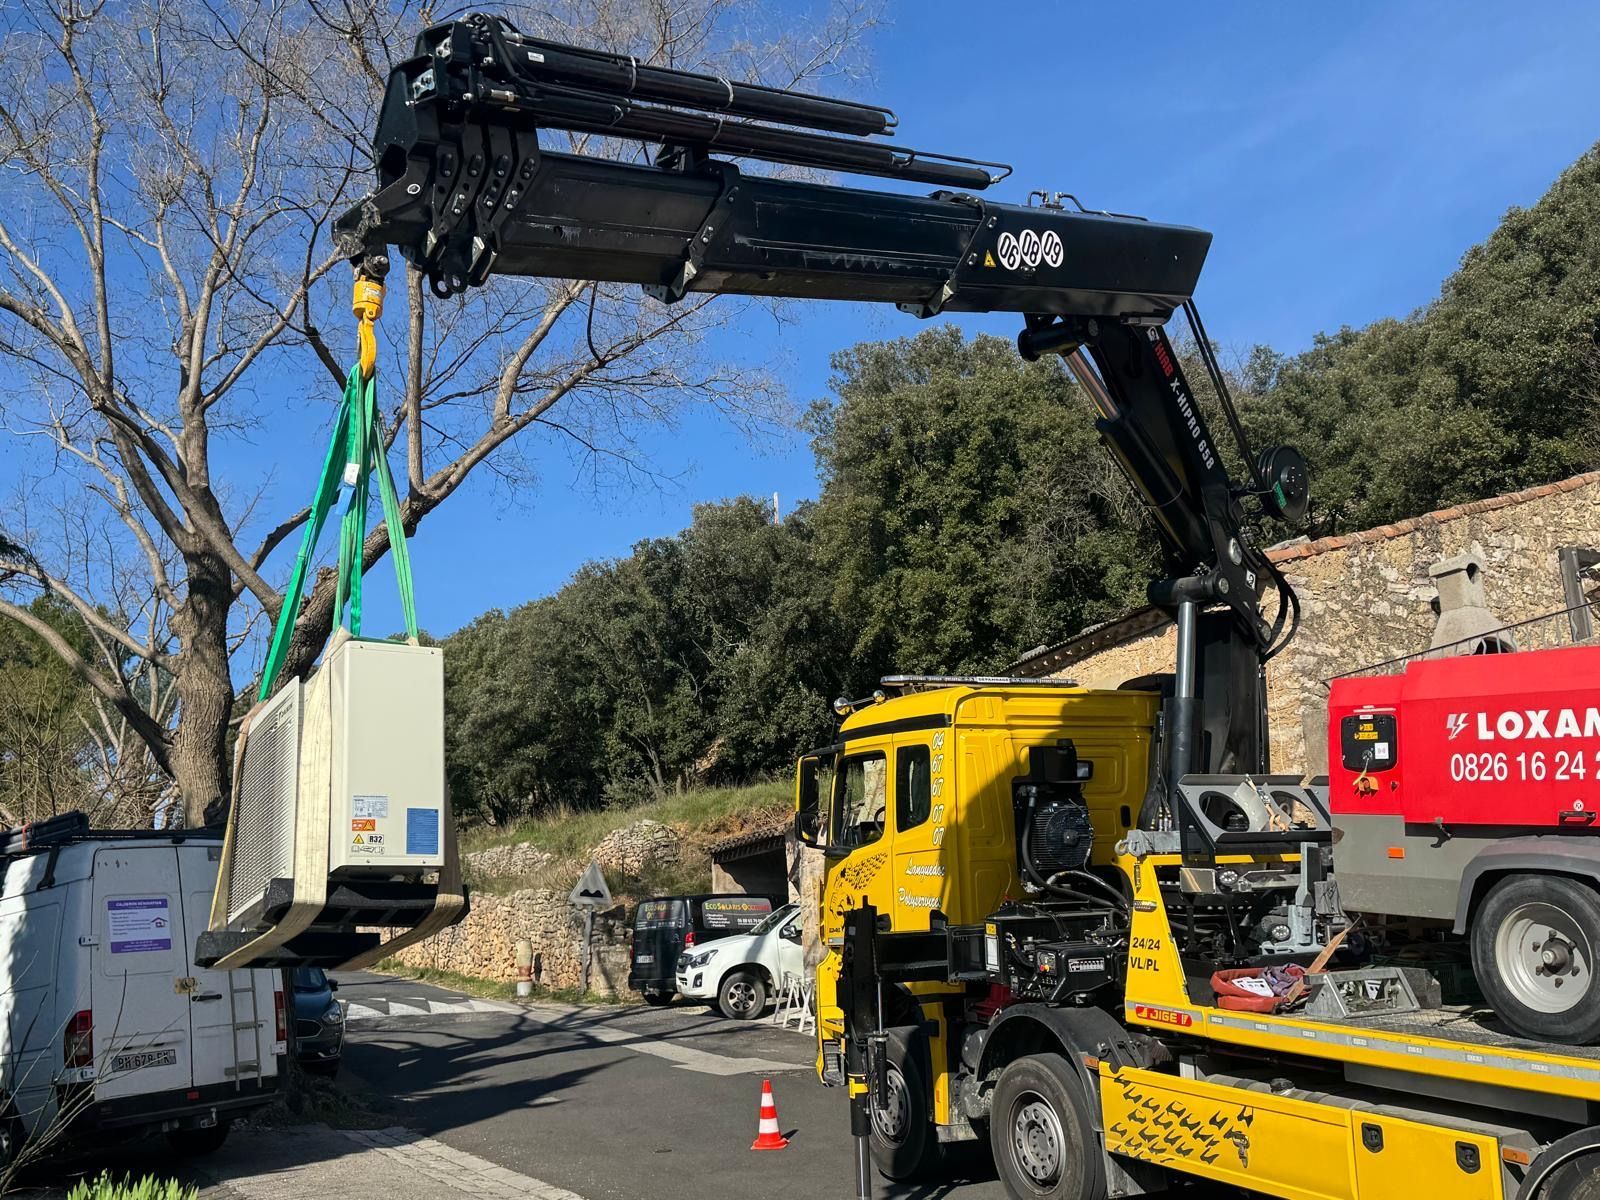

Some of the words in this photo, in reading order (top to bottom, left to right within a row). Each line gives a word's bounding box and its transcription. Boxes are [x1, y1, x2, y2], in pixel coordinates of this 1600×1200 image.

[1154, 342, 1174, 377] HIAB
[1170, 377, 1201, 439] X-HIPRO
[1198, 439, 1215, 470] 658
[932, 732, 945, 751] 04
[932, 754, 944, 774] 67
[1451, 752, 1508, 782] 0826
[1516, 751, 1547, 781] 16
[1555, 750, 1586, 780] 24
[932, 778, 944, 798] 67
[932, 804, 944, 824] 07
[369, 835, 382, 843] R32
[933, 827, 945, 846] 07
[1132, 937, 1161, 951] 24/24
[1130, 956, 1160, 972] VL/PL
[1149, 1010, 1178, 1023] JIGE
